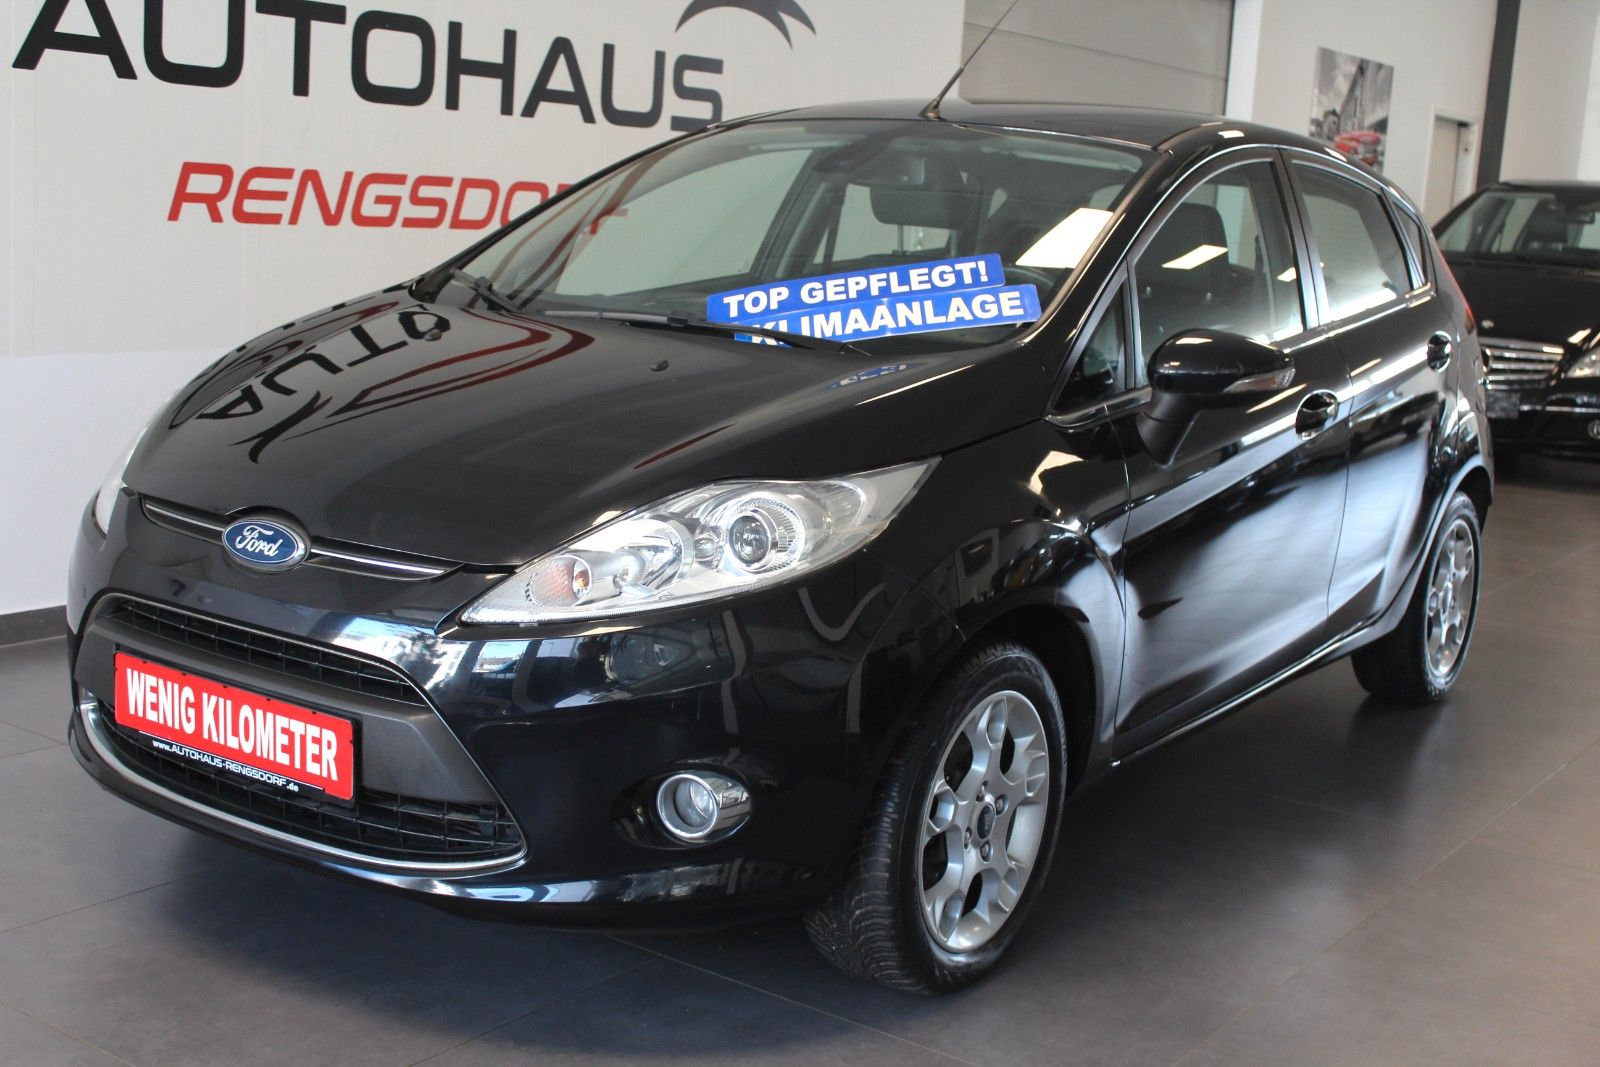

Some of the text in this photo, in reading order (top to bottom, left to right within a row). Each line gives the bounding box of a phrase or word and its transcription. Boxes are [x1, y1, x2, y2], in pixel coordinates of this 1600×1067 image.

[12, 0, 724, 132] AUTOHAUS
[167, 161, 629, 236] RENGSDOF
[723, 260, 989, 318] TOP GEPFLEGT!
[235, 525, 283, 557] Ford
[126, 667, 338, 781] WENIG KILOMETER
